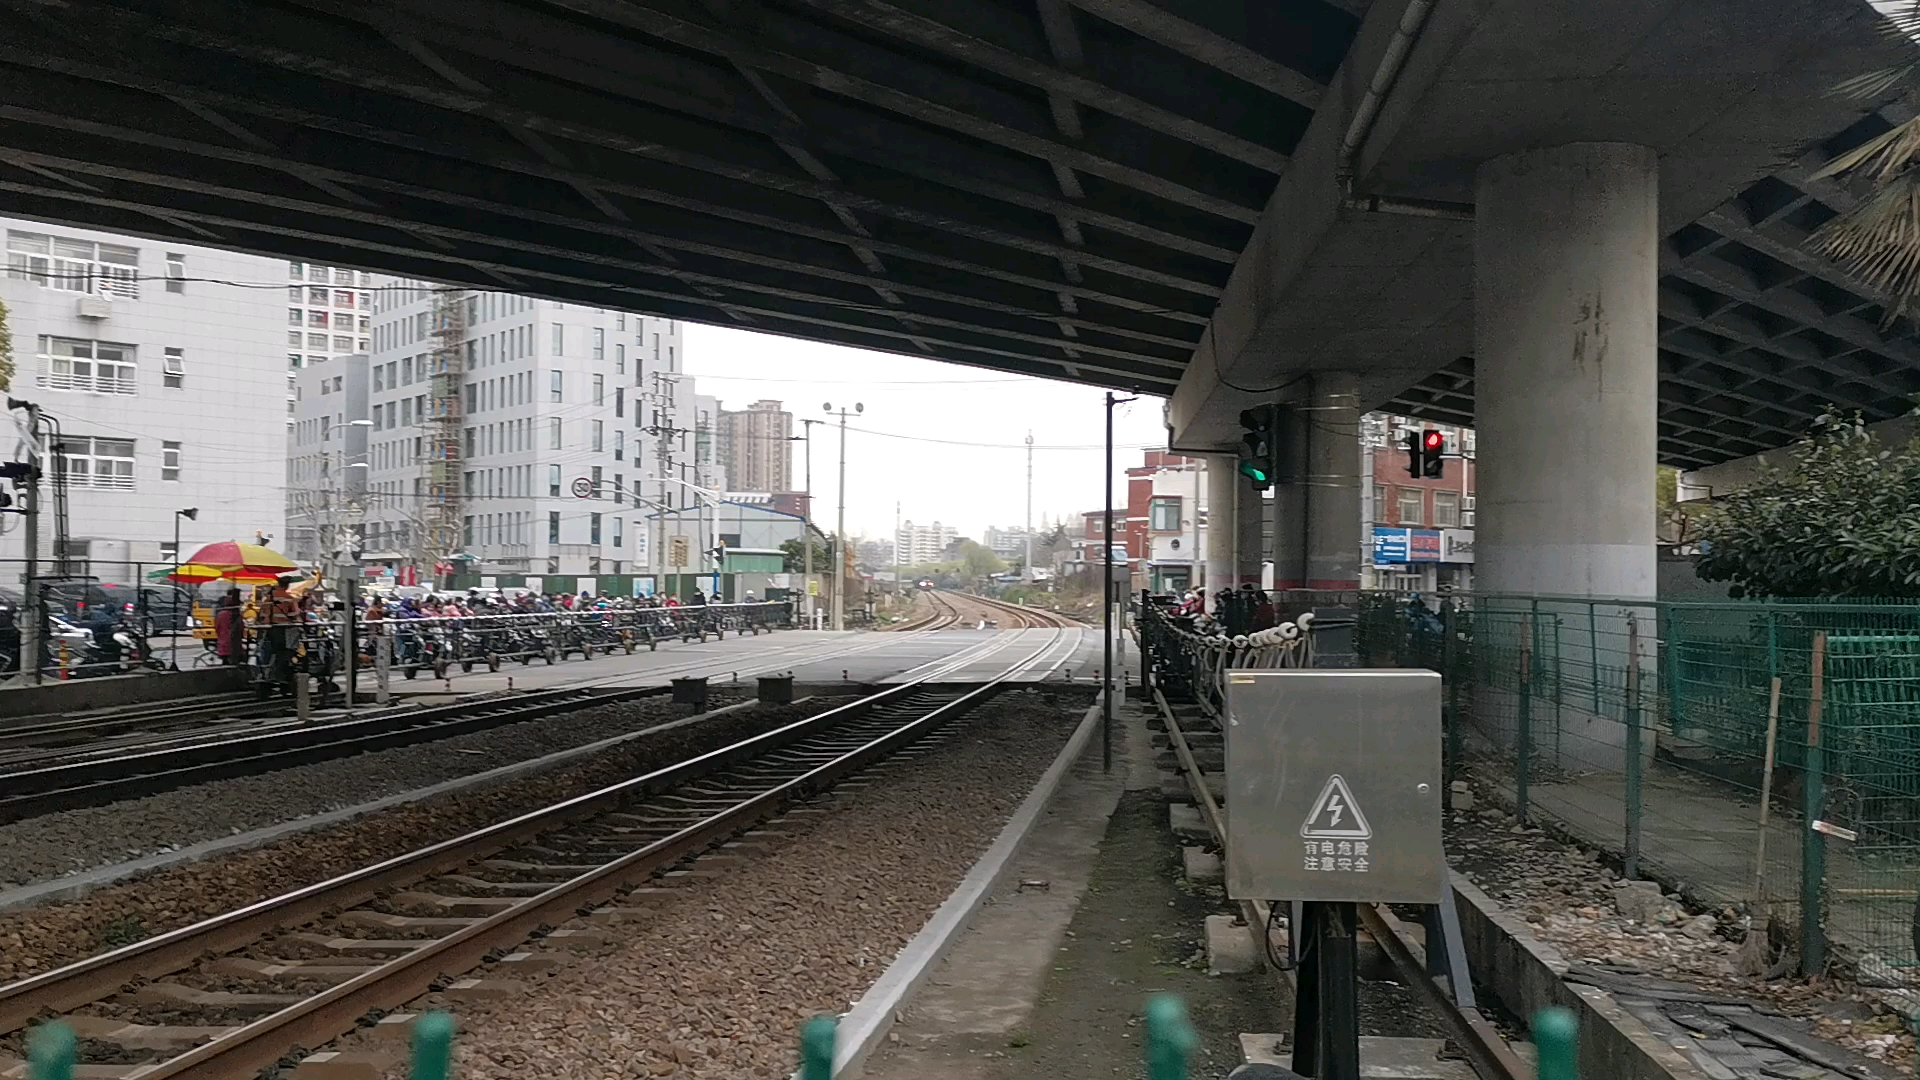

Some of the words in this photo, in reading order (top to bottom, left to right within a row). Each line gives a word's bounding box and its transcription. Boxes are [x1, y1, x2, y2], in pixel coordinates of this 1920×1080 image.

[1304, 840, 1369, 855] 有电危险
[1304, 856, 1369, 872] 注意安全
